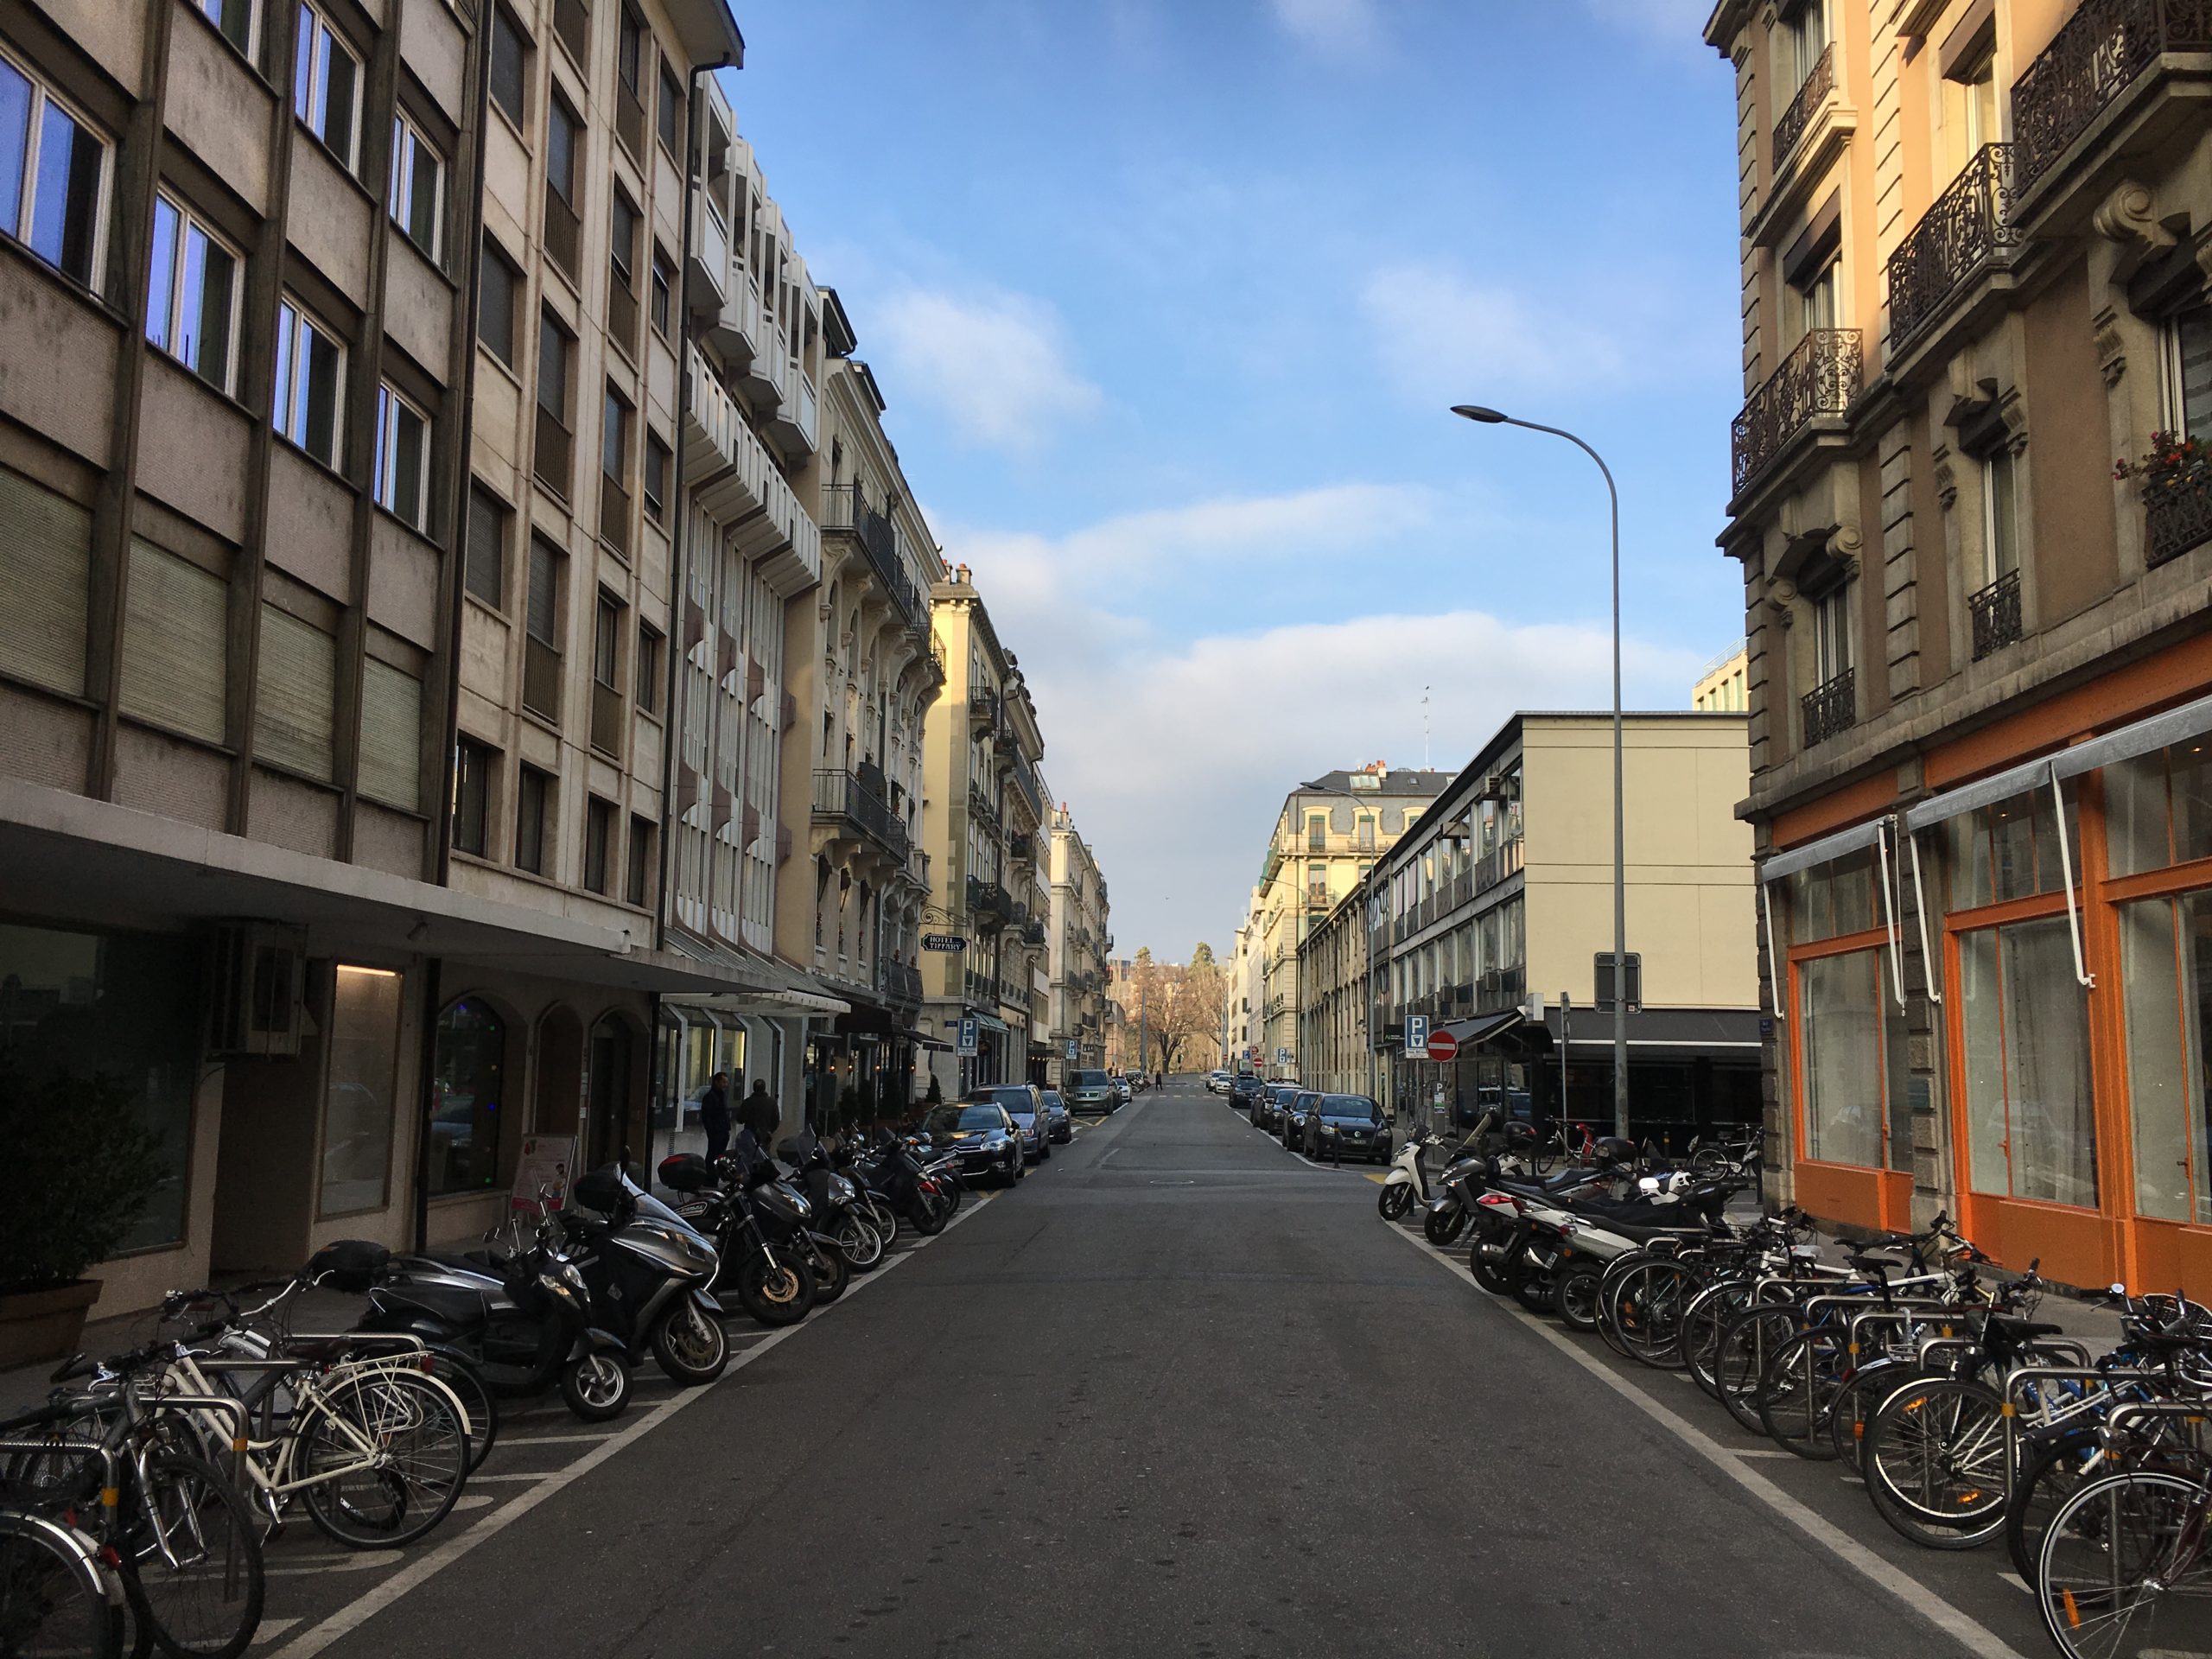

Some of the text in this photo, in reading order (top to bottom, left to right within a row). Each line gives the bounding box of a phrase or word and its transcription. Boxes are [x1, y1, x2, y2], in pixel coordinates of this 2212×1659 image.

[963, 1020, 973, 1034] P
[1412, 1018, 1422, 1033] P
[1069, 1040, 1075, 1049] P
[1280, 1048, 1285, 1057] P
[1436, 1083, 1443, 1092] P
